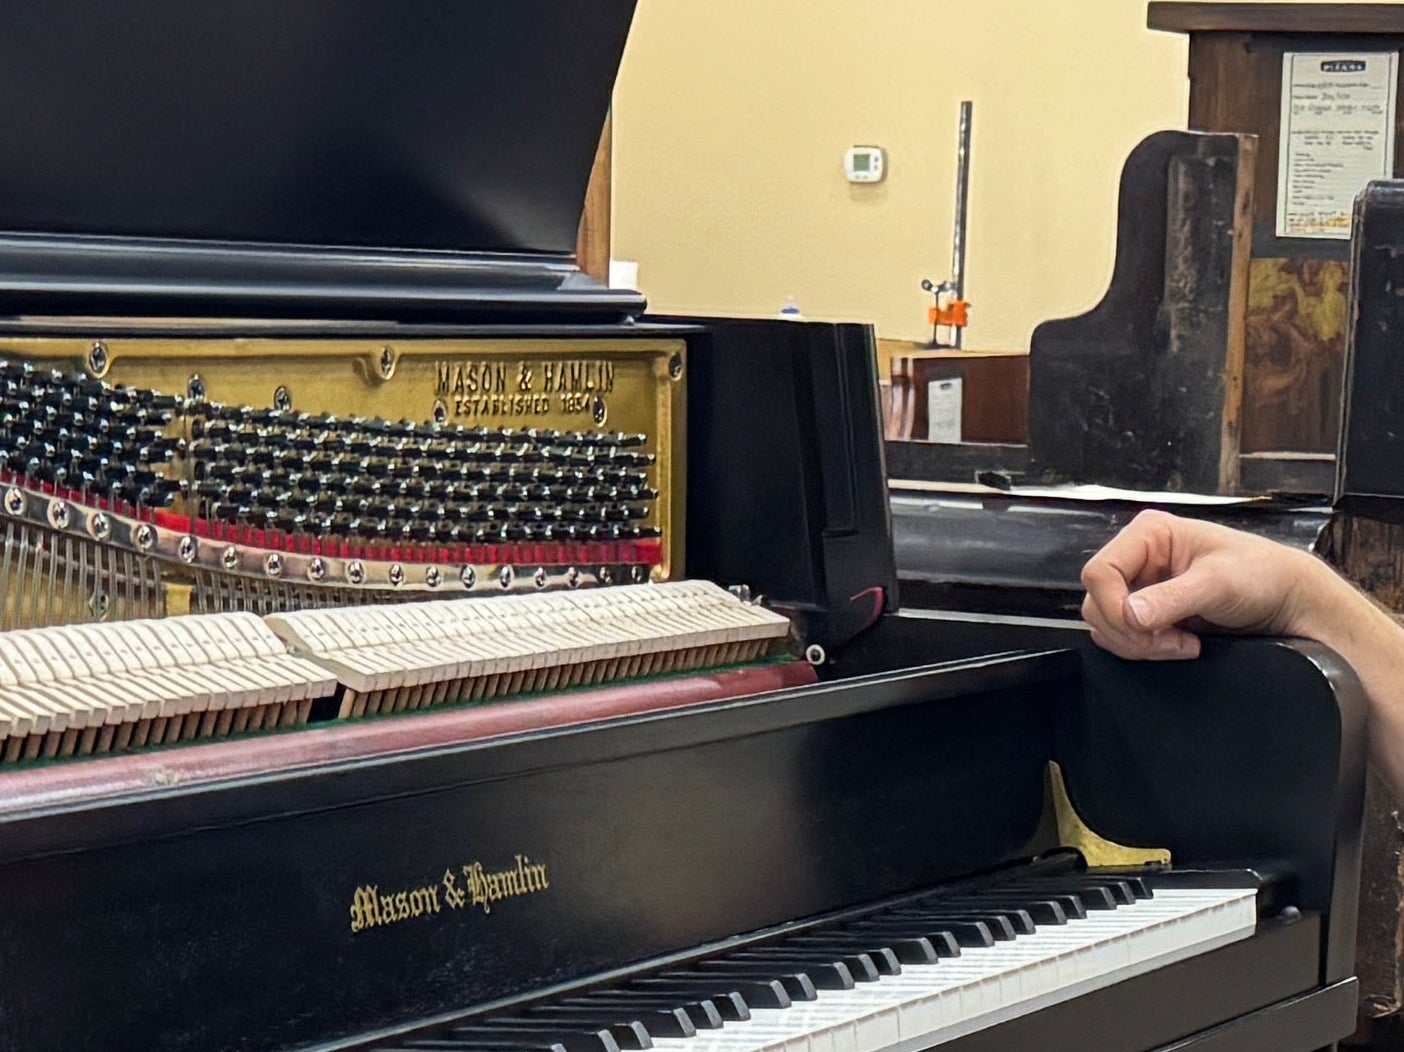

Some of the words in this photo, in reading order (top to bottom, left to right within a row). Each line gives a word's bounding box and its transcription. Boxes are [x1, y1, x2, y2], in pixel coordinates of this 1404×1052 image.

[434, 360, 506, 394] MASON
[516, 360, 534, 390] &
[542, 360, 615, 393] HAMLIN
[453, 394, 550, 416] ESTABLISHED
[350, 884, 441, 933] Mason
[443, 868, 465, 908] &
[463, 854, 550, 914] Hamlin
